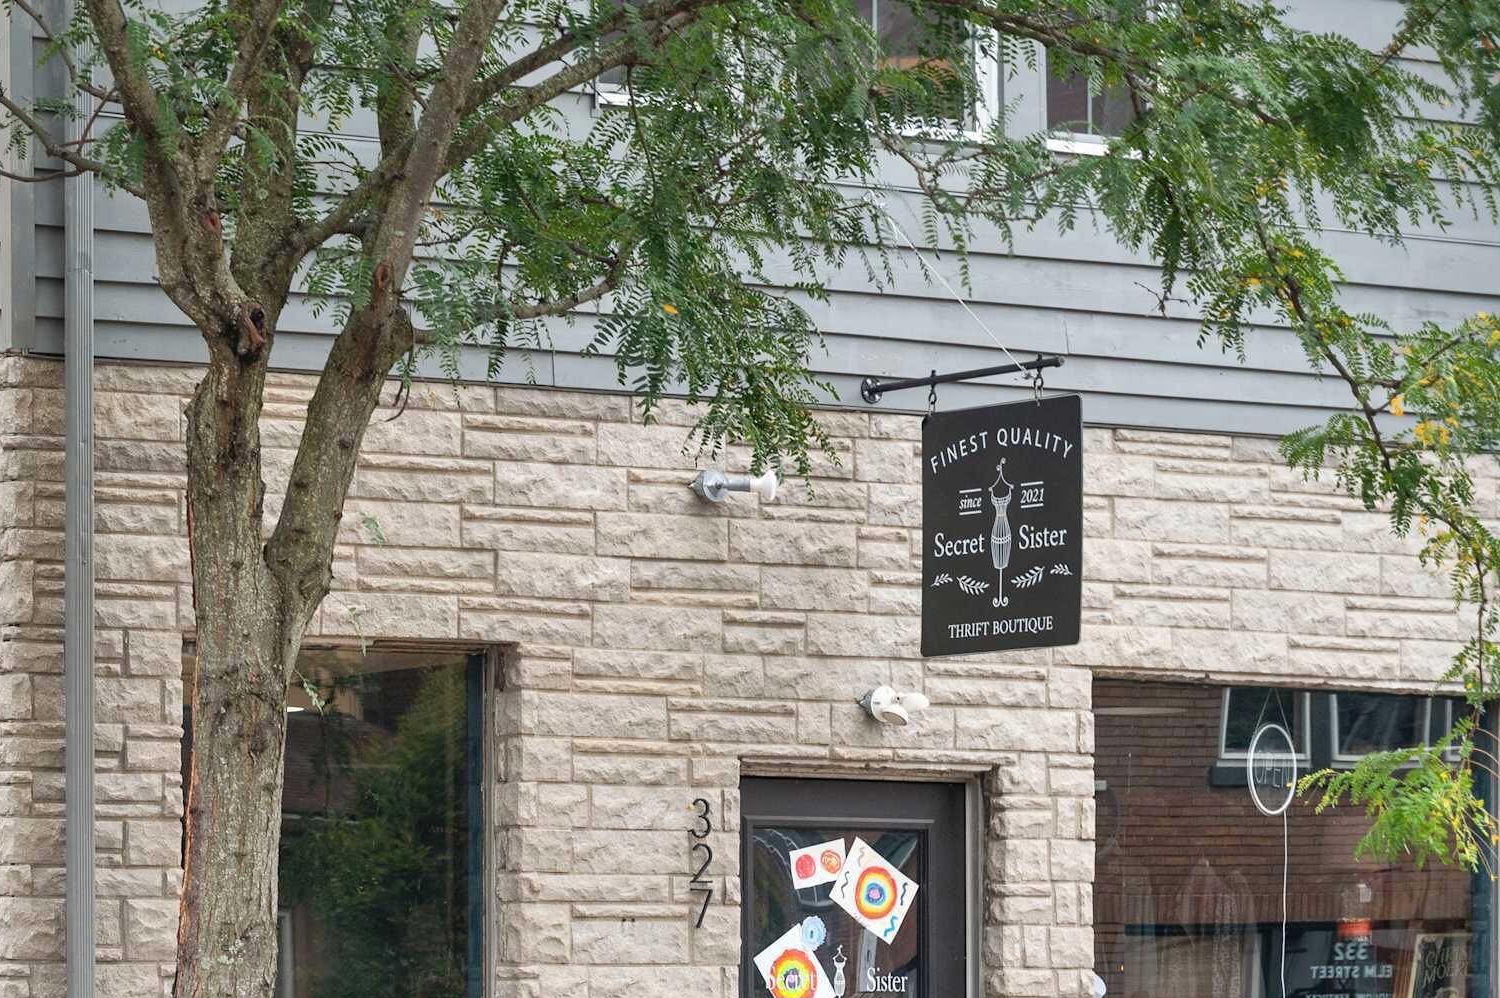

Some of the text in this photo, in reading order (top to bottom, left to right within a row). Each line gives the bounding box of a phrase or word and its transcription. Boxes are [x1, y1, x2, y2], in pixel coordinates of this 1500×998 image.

[930, 427, 1073, 474] FINEST QUALITY
[959, 487, 1044, 510] since 2021
[934, 525, 1068, 557] Secret Sister
[948, 615, 1053, 639] THRIFT BOUTIQUE
[687, 798, 713, 928] 327
[866, 967, 908, 993] Sister
